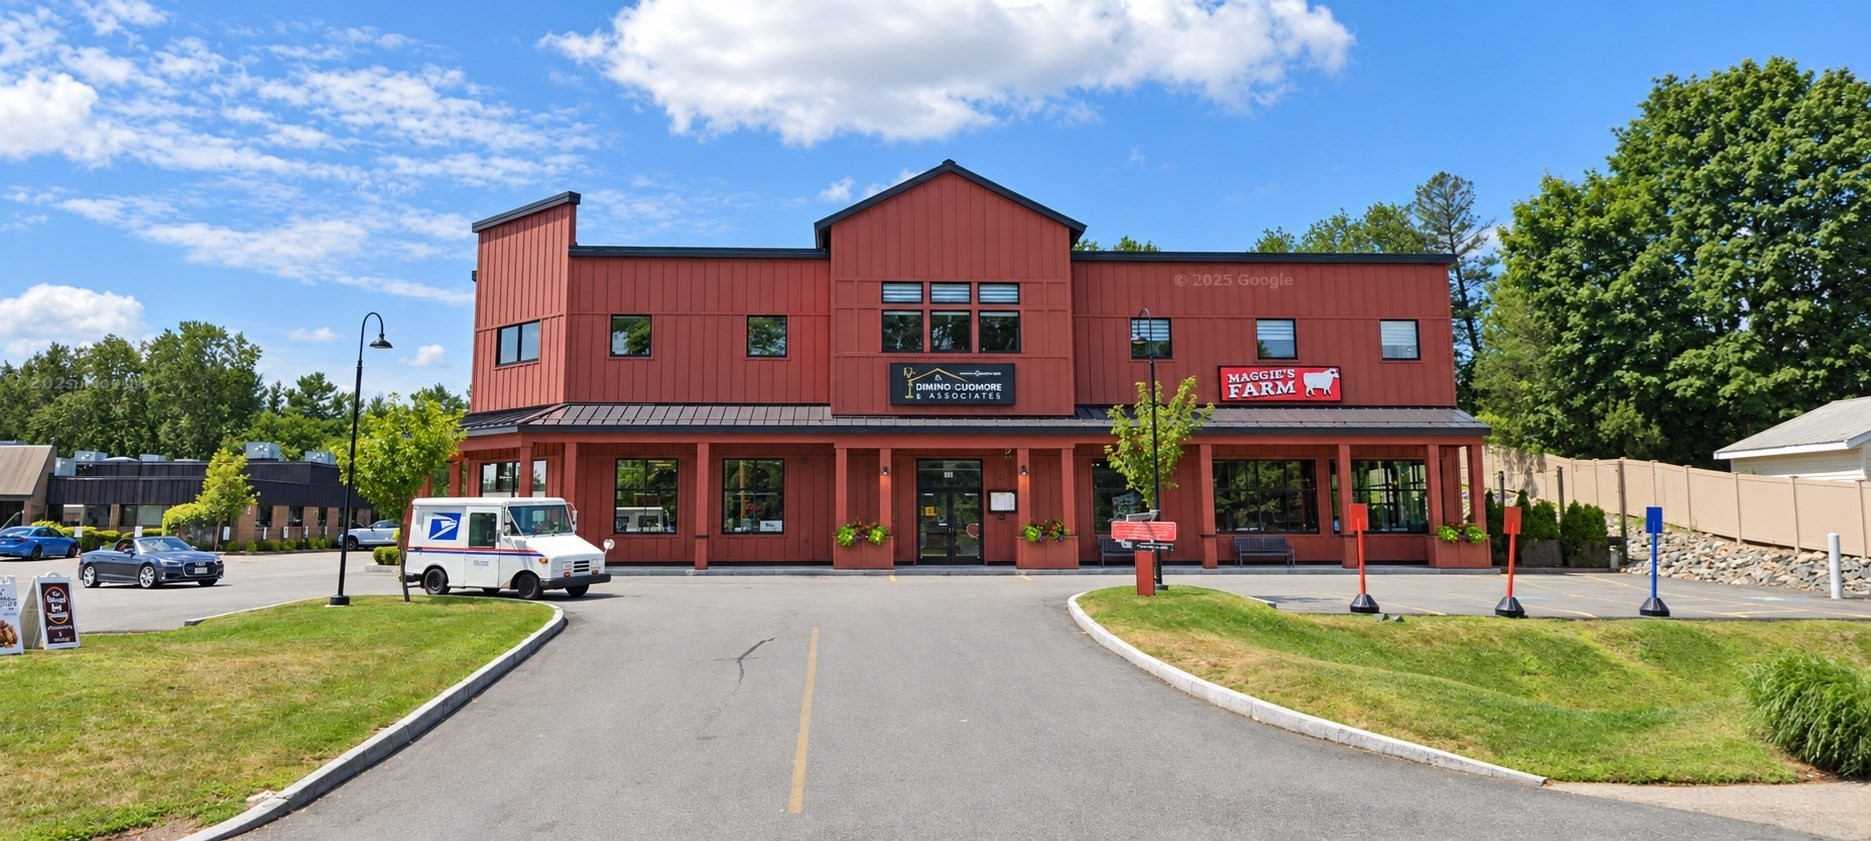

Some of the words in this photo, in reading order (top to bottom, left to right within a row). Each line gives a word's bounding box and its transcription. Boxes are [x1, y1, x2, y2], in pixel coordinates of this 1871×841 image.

[1227, 368, 1295, 384] MAGGIE'S
[915, 383, 951, 391] DIMINO
[954, 383, 1002, 391] CUOMORE
[1227, 380, 1296, 398] FARM
[928, 392, 1001, 400] ASSOCIATES
